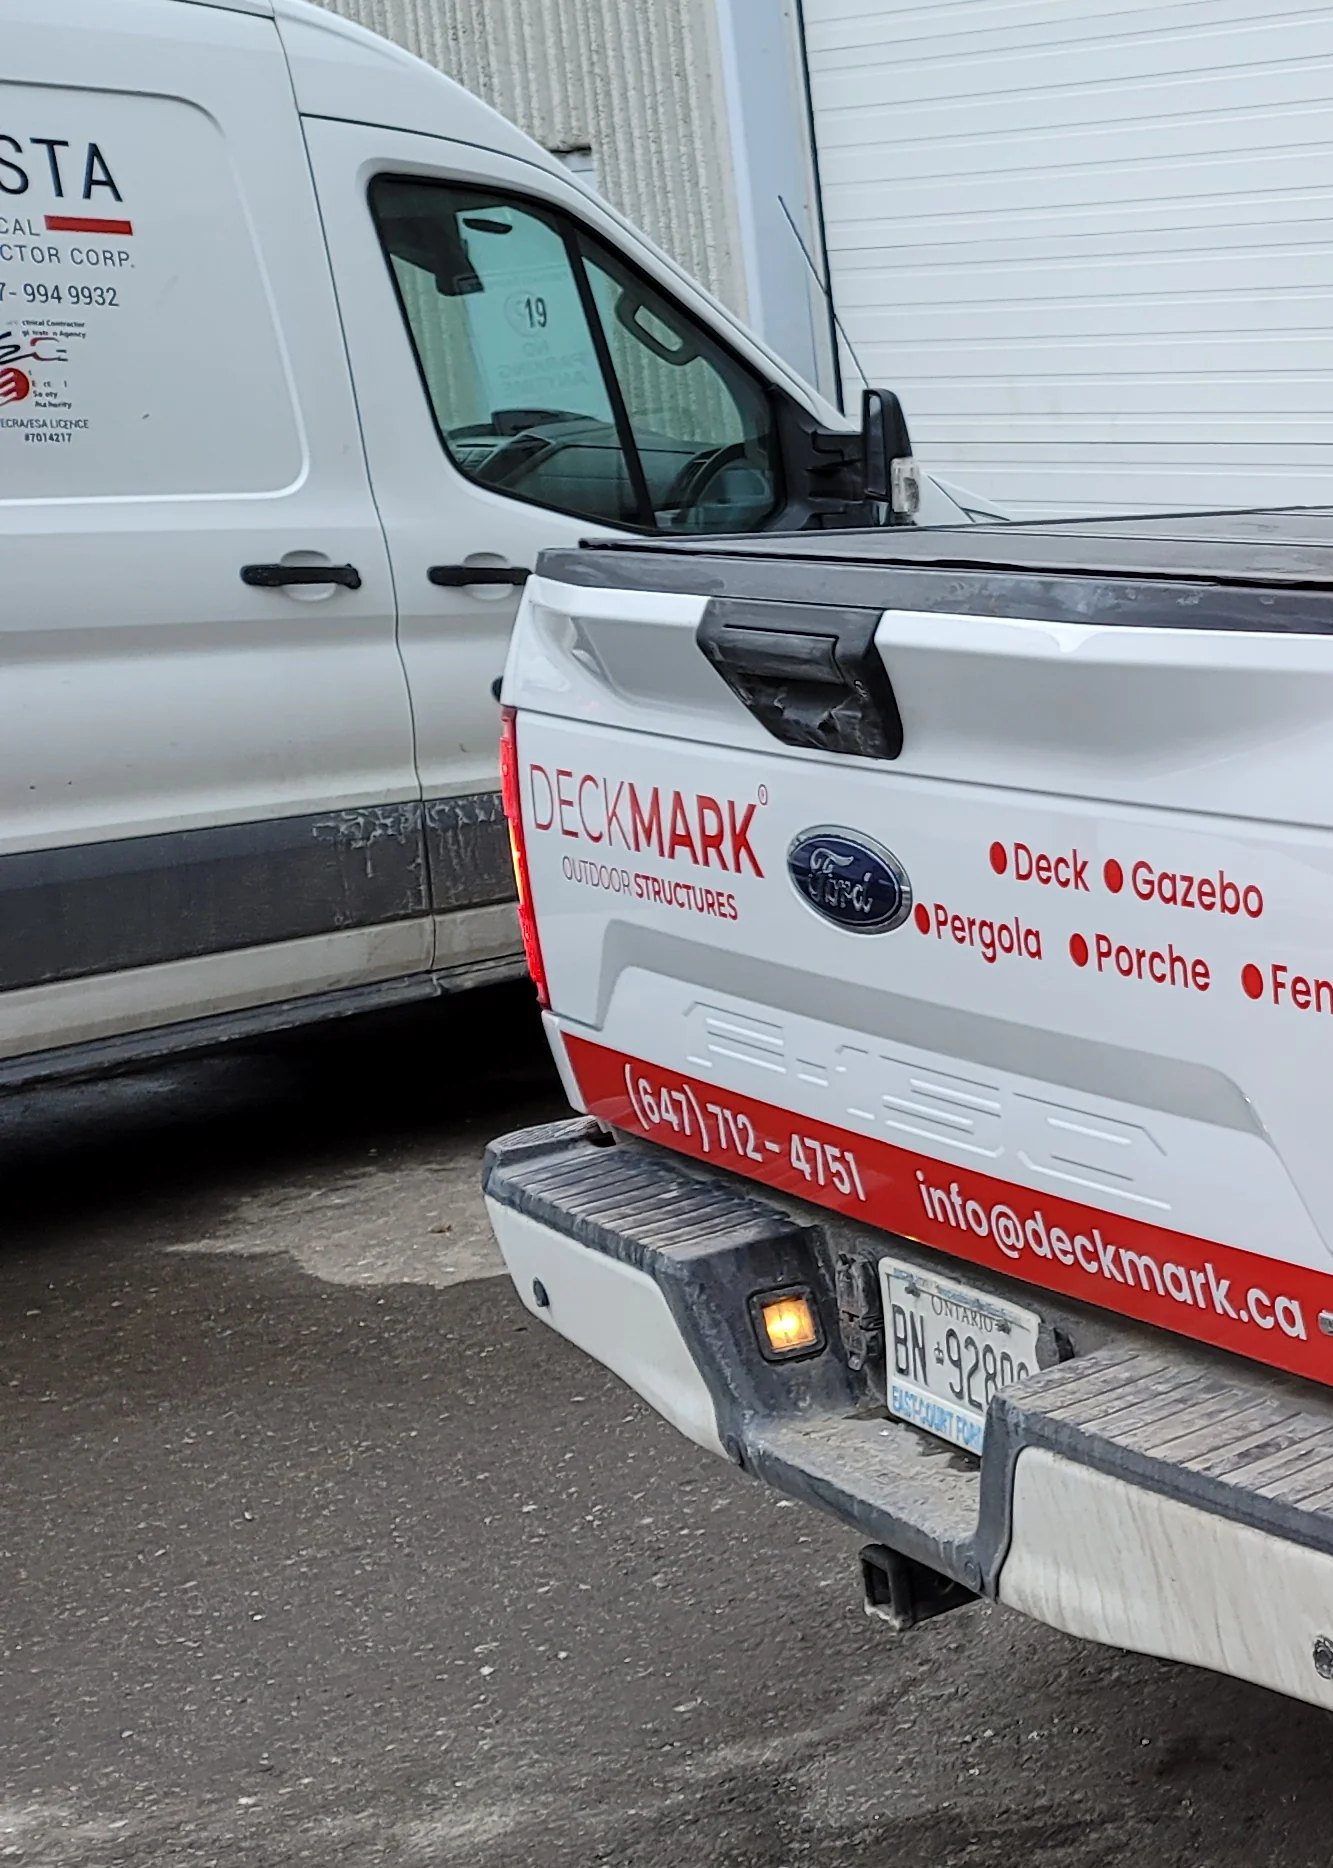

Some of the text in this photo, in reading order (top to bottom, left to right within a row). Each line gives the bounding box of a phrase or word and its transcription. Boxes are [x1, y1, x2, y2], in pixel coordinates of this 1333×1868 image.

[0, 244, 135, 268] CTOR CORP.
[23, 283, 62, 304] 994
[67, 286, 120, 307] 9932
[524, 297, 548, 328] 19
[50, 419, 89, 430] LICENCE
[562, 855, 738, 921] OUTDOOR STRUCTURES
[808, 847, 873, 914] Ford
[1013, 841, 1264, 918] Deck Gazebo
[934, 903, 1043, 964] Pergola
[1094, 933, 1211, 992] Porche
[624, 1062, 710, 1152] (647)
[705, 1102, 764, 1163] 712
[789, 1133, 867, 1201] 4751
[916, 1170, 1308, 1342] info@deckmark.ca
[930, 1294, 993, 1333] ONTARIO
[891, 1303, 1030, 1413] BN 9280
